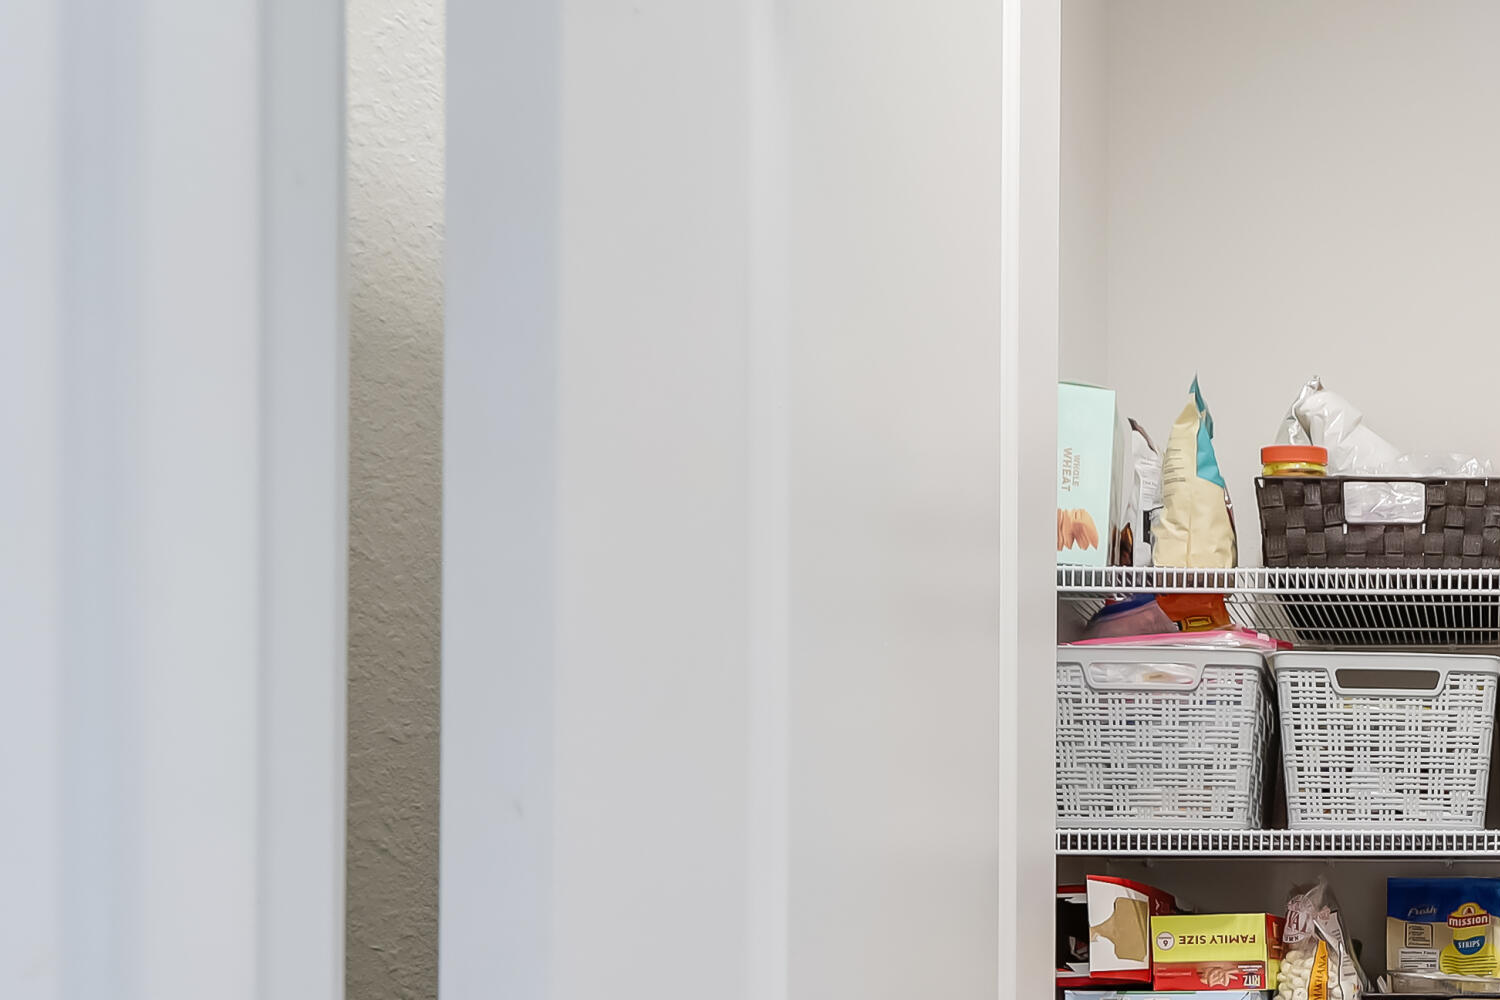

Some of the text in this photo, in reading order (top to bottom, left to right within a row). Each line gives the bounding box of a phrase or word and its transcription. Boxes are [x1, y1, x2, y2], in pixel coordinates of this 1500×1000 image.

[1061, 447, 1073, 492] WHEAT
[1073, 454, 1081, 487] WHOLE
[1178, 935, 1207, 945] SIZE
[1209, 934, 1256, 944] FAMILY
[1243, 974, 1261, 987] RITZ
